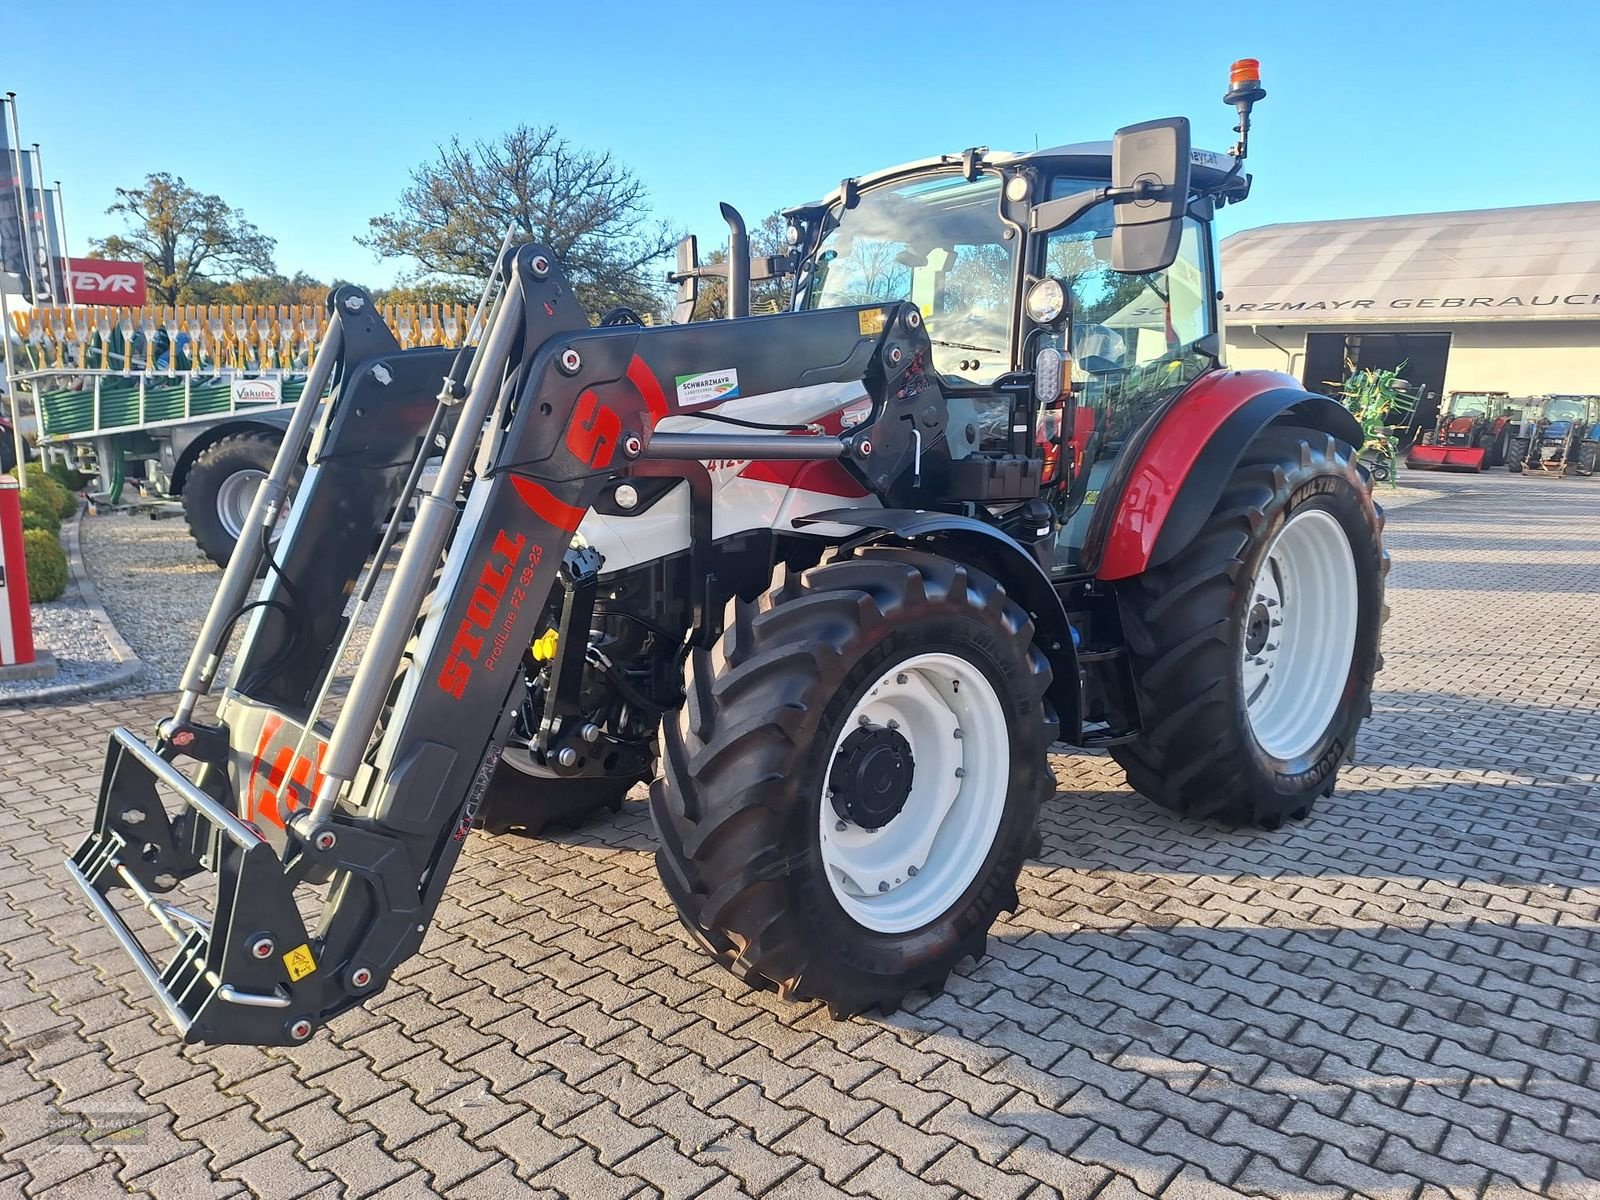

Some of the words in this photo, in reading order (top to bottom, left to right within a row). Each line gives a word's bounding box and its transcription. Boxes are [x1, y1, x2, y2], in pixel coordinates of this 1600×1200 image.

[64, 271, 136, 294] TEYR
[236, 387, 276, 400] Vakutec
[682, 376, 730, 390] SCHWARZMAYR
[437, 527, 527, 700] STOLL
[484, 611, 517, 672] ProfiLine
[519, 543, 544, 588] 39-23
